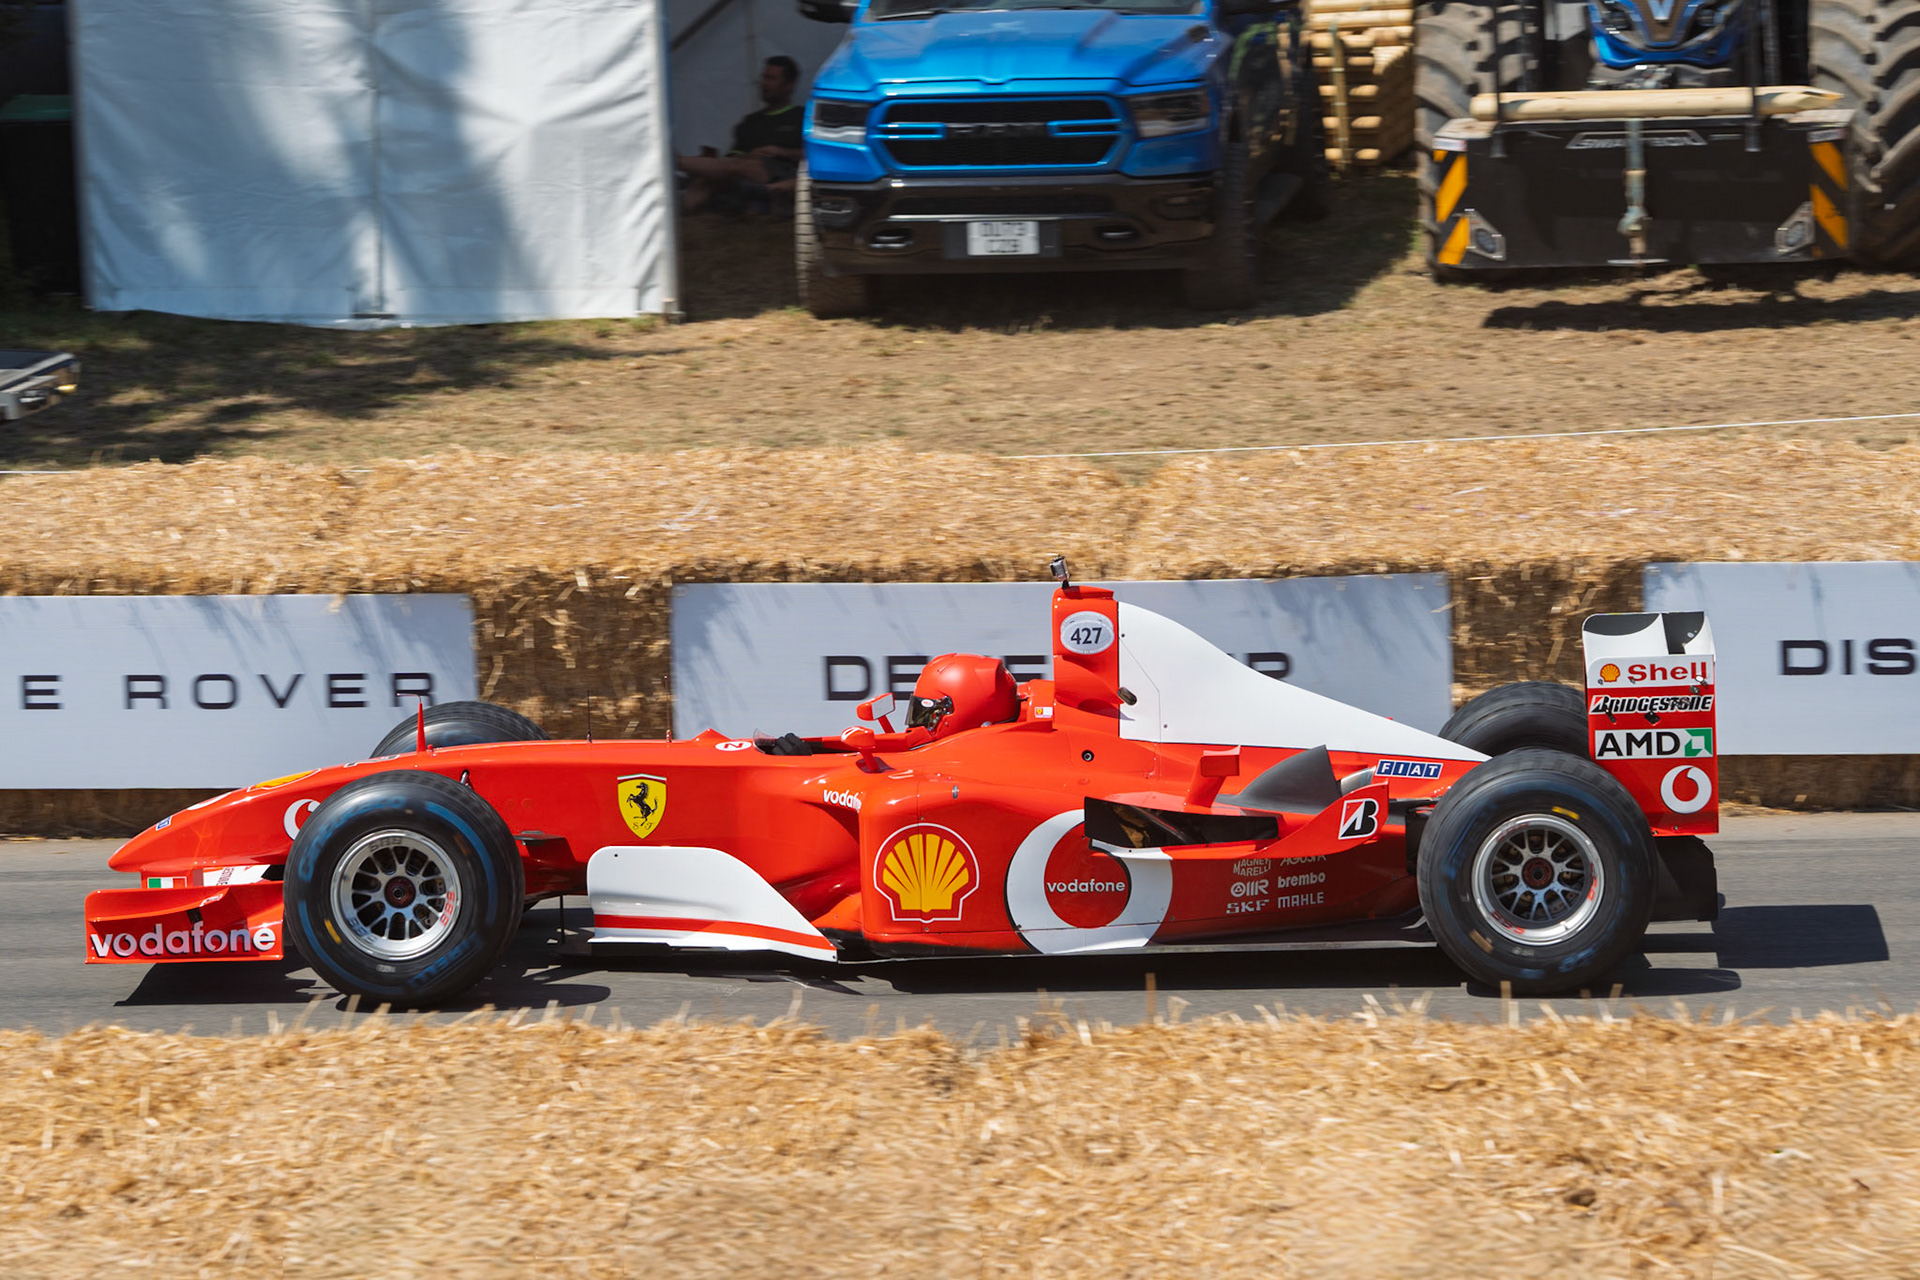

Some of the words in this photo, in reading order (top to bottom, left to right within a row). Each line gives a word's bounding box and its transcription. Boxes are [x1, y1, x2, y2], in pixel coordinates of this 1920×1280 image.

[1070, 627, 1103, 645] 427
[1780, 638, 1917, 675] DIS
[1628, 661, 1707, 682] Shell
[20, 674, 62, 709] E
[123, 672, 437, 709] ROVER
[1597, 731, 1681, 757] AMD
[1381, 763, 1438, 776] FIAT
[1046, 879, 1126, 893] vodafone
[1277, 872, 1326, 889] brembo
[1226, 899, 1270, 914] SKF
[1277, 891, 1325, 909] MAHLE
[90, 921, 276, 958] vodafone
